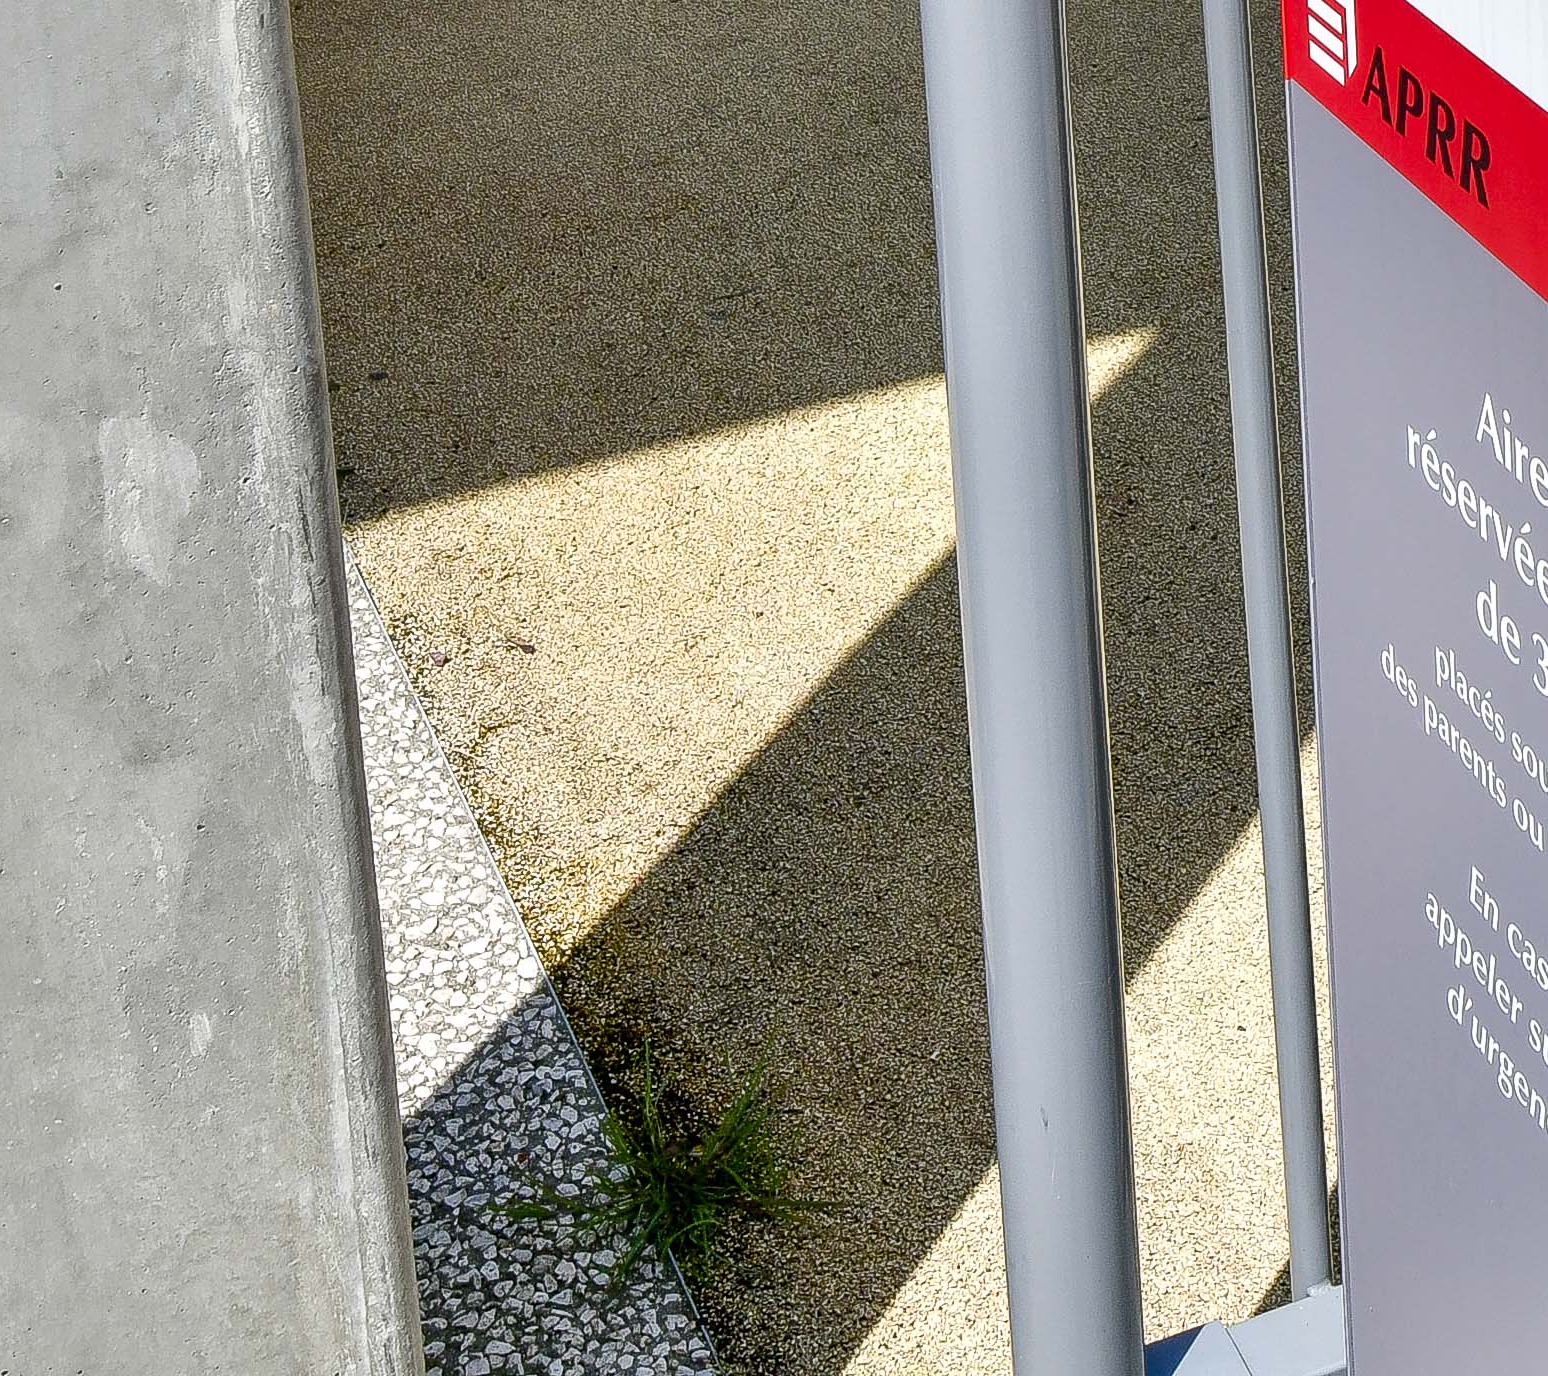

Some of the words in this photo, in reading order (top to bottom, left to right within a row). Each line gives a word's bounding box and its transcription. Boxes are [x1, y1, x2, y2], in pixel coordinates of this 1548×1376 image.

[1361, 44, 1491, 209] APRR
[1475, 579, 1521, 665] de
[1381, 644, 1419, 708] des
[1423, 695, 1507, 809] parents
[1513, 798, 1544, 852] ou
[1434, 646, 1507, 744] placés
[1469, 864, 1500, 932] En
[1425, 892, 1524, 1024] appeler
